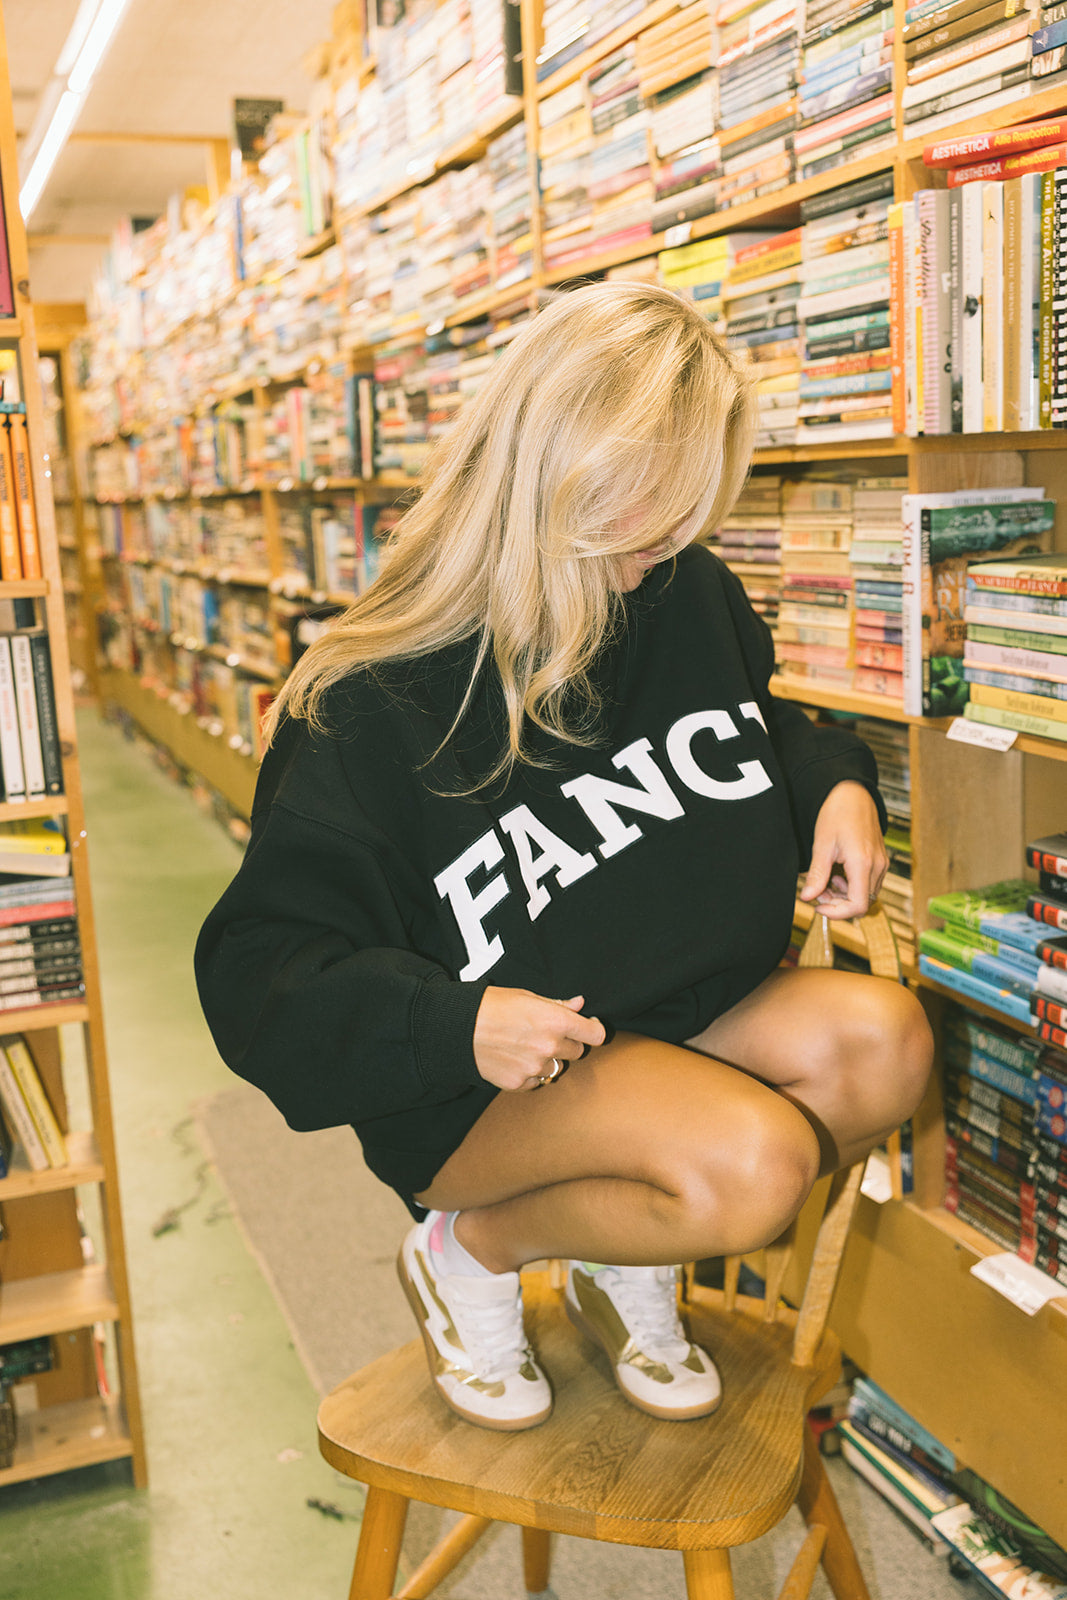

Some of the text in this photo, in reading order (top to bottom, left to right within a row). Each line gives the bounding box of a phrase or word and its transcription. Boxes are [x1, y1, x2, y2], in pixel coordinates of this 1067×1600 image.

[932, 125, 1061, 160] AESTHETICA Allie Rowbottom
[954, 150, 1060, 182] AESTHETICA Allie Rowbottom
[1044, 180, 1052, 201] THE
[1043, 315, 1051, 385] LUCINDA ROY
